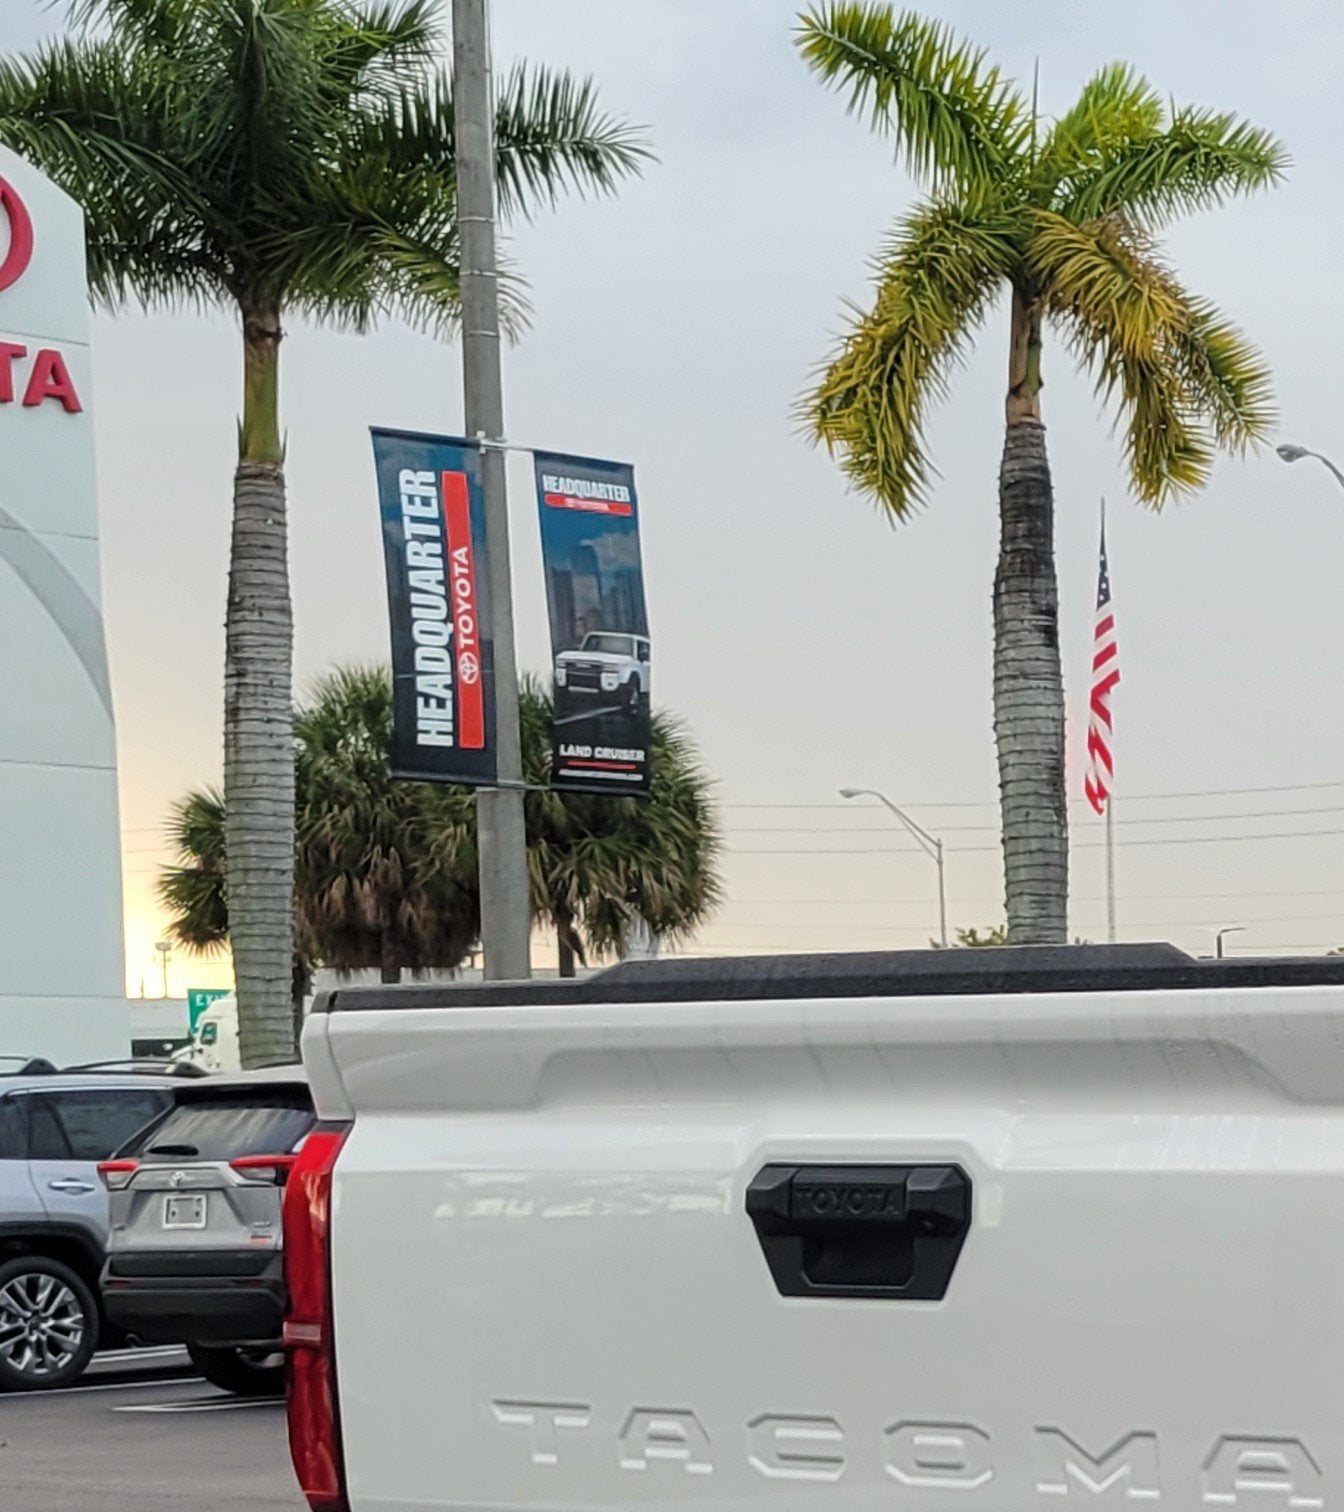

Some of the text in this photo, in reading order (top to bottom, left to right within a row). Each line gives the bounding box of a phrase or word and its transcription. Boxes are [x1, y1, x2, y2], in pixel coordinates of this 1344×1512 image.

[541, 473, 631, 503] HEADQUARTER
[400, 467, 455, 748] HEADQUARTER
[452, 546, 475, 649] TOYOTA
[558, 743, 646, 763] LAND CRUISER
[796, 1188, 900, 1215] TOYOTA
[492, 1399, 1324, 1506] TACOMA
